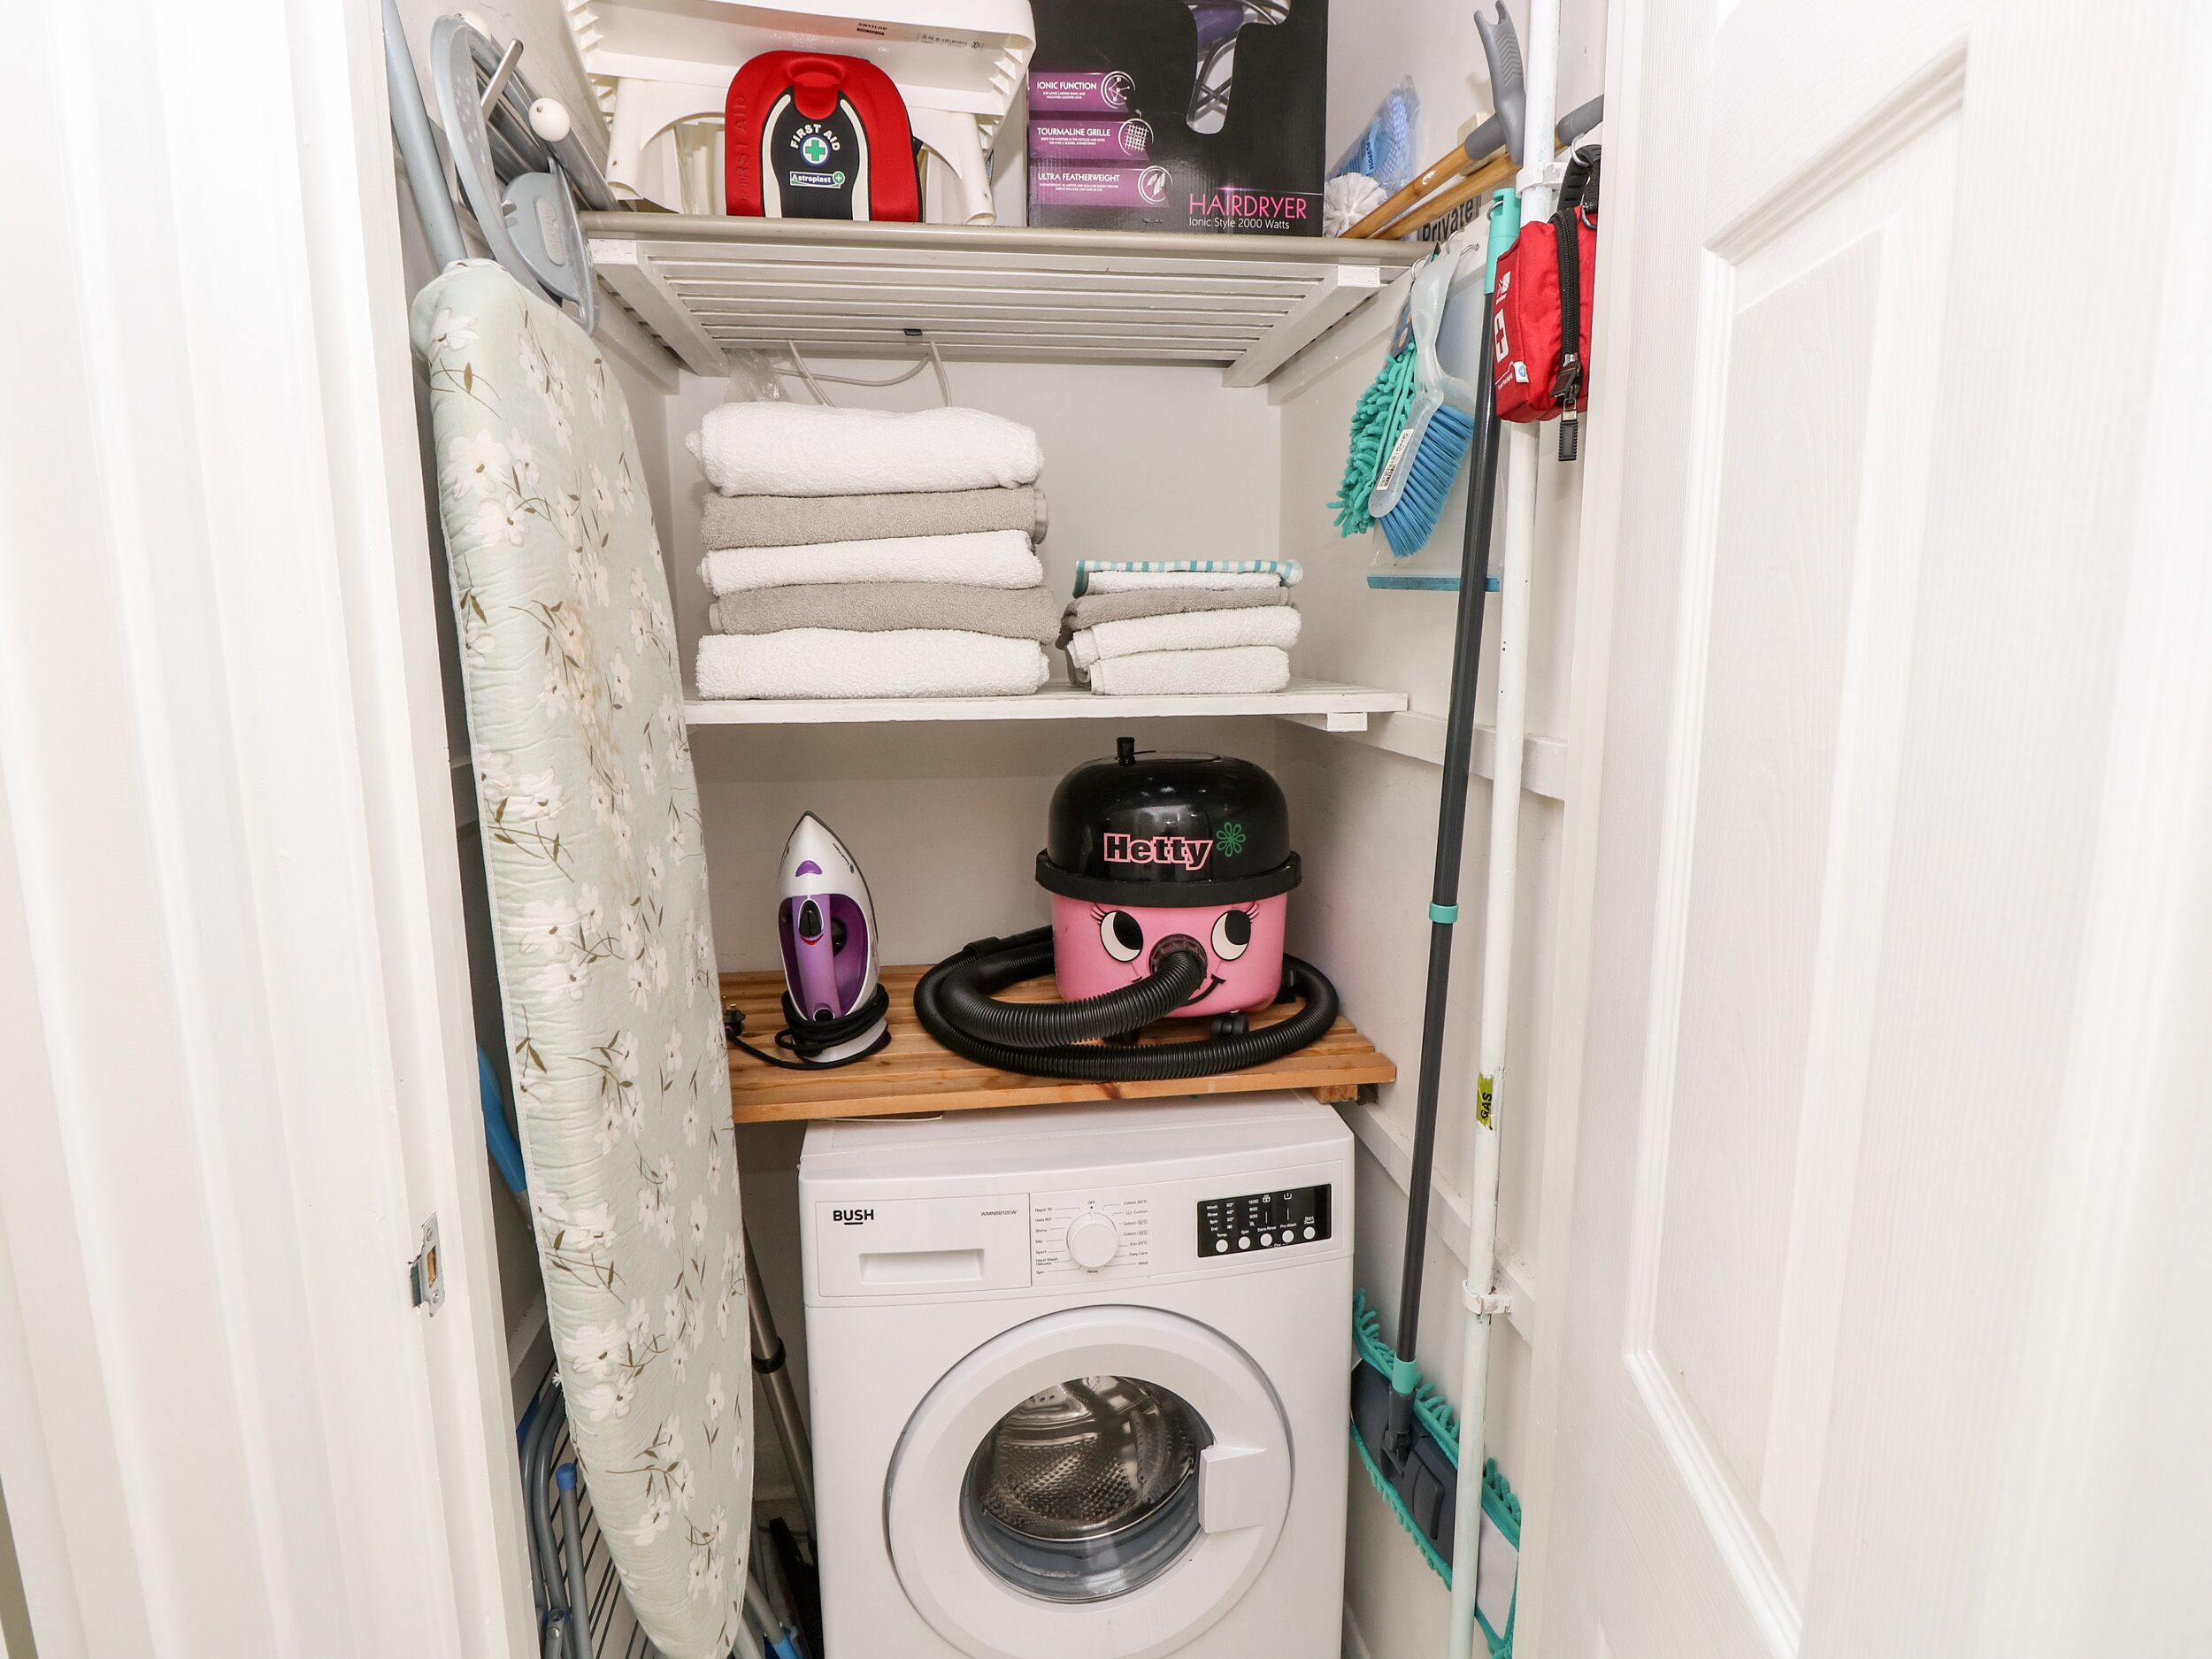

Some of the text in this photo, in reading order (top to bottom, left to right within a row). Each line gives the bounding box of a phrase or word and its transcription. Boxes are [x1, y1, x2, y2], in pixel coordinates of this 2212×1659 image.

[790, 124, 841, 150] FIRST AID
[1037, 127, 1085, 136] TOURMALINE
[792, 174, 831, 183] Astroplast
[1189, 193, 1307, 219] HAIRDRYER
[1189, 217, 1290, 229] Ionic Style 2000 Watts
[1103, 833, 1214, 871] Hetty
[1481, 1092, 1492, 1119] GAS
[833, 1209, 874, 1222] BUSH
